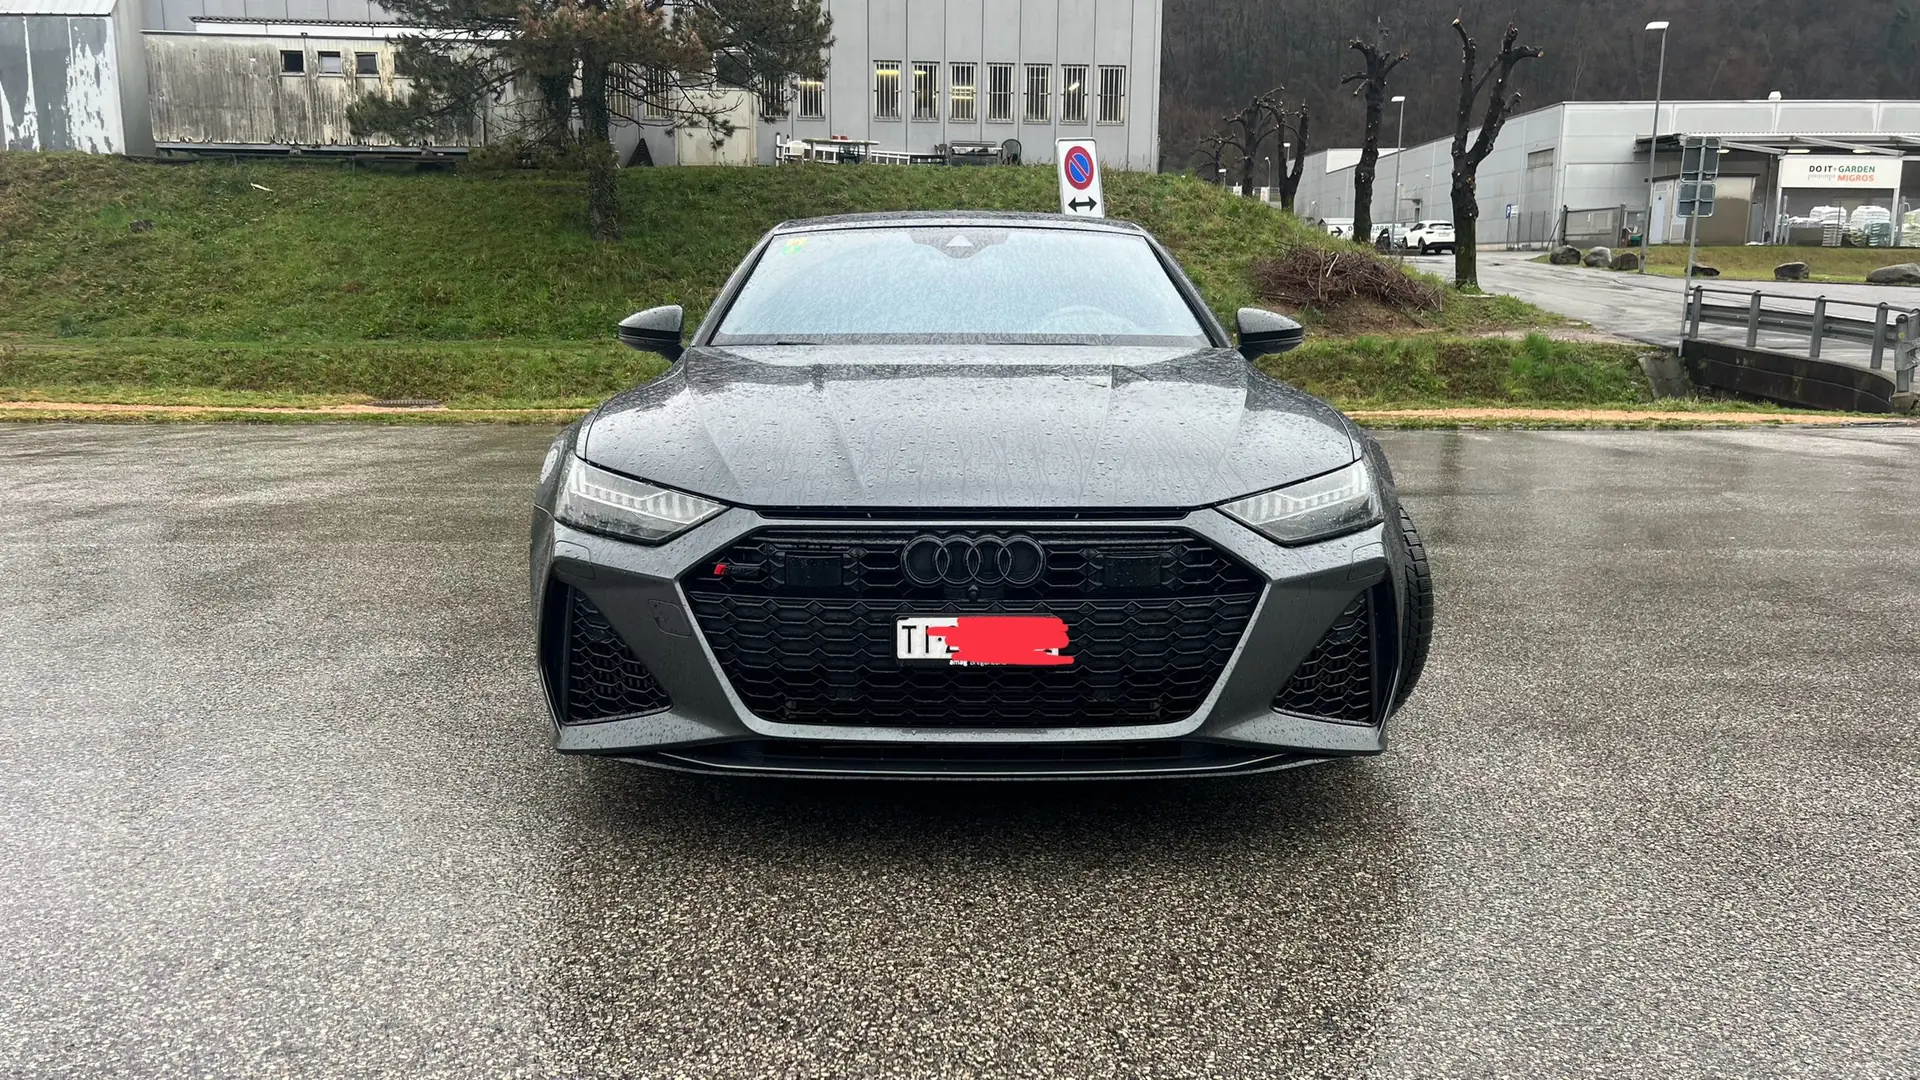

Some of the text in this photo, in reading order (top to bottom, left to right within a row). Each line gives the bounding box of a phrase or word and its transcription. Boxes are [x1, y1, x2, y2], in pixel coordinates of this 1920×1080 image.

[1809, 165, 1823, 173] DO
[1824, 165, 1833, 173] IT
[1838, 165, 1876, 173] GARDEN
[1837, 174, 1875, 182] MIGROS
